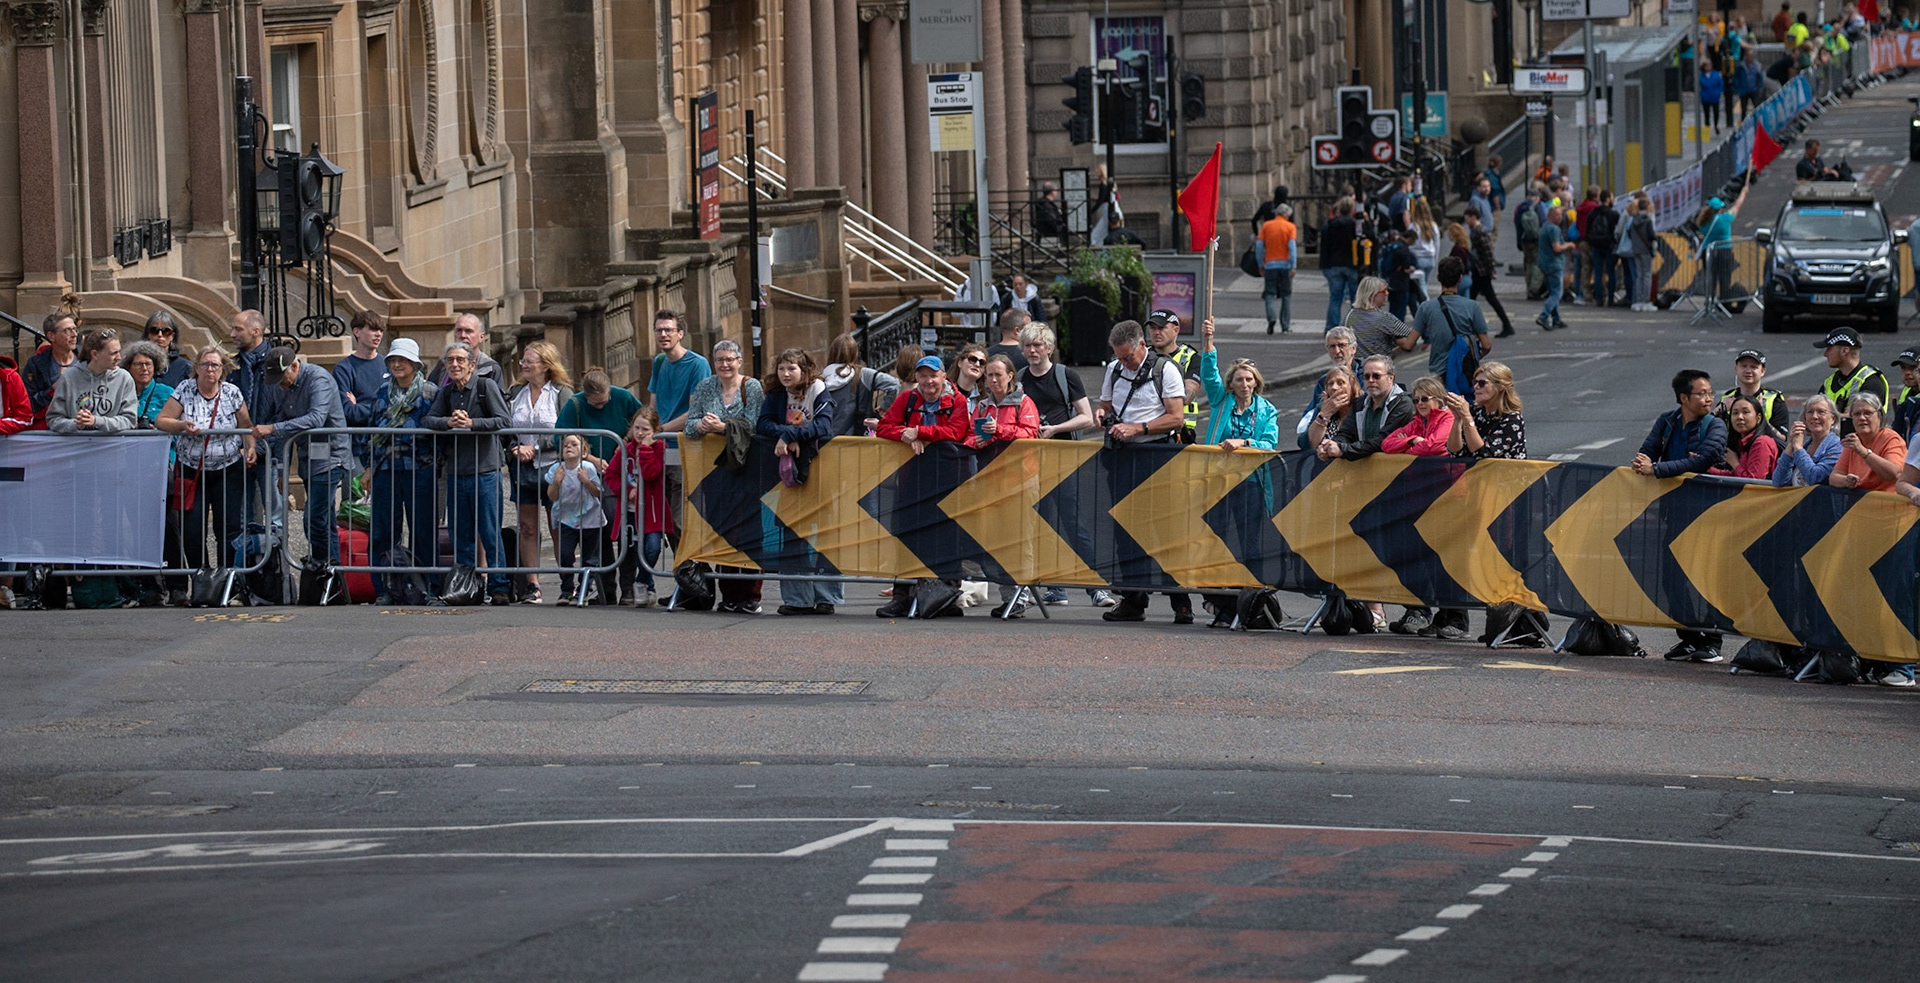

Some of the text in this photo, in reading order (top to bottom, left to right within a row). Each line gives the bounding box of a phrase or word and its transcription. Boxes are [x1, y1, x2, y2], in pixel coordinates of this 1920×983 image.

[1549, 8, 1576, 16] traffic
[919, 15, 973, 24] MERCHANT
[1529, 71, 1568, 83] BigMat
